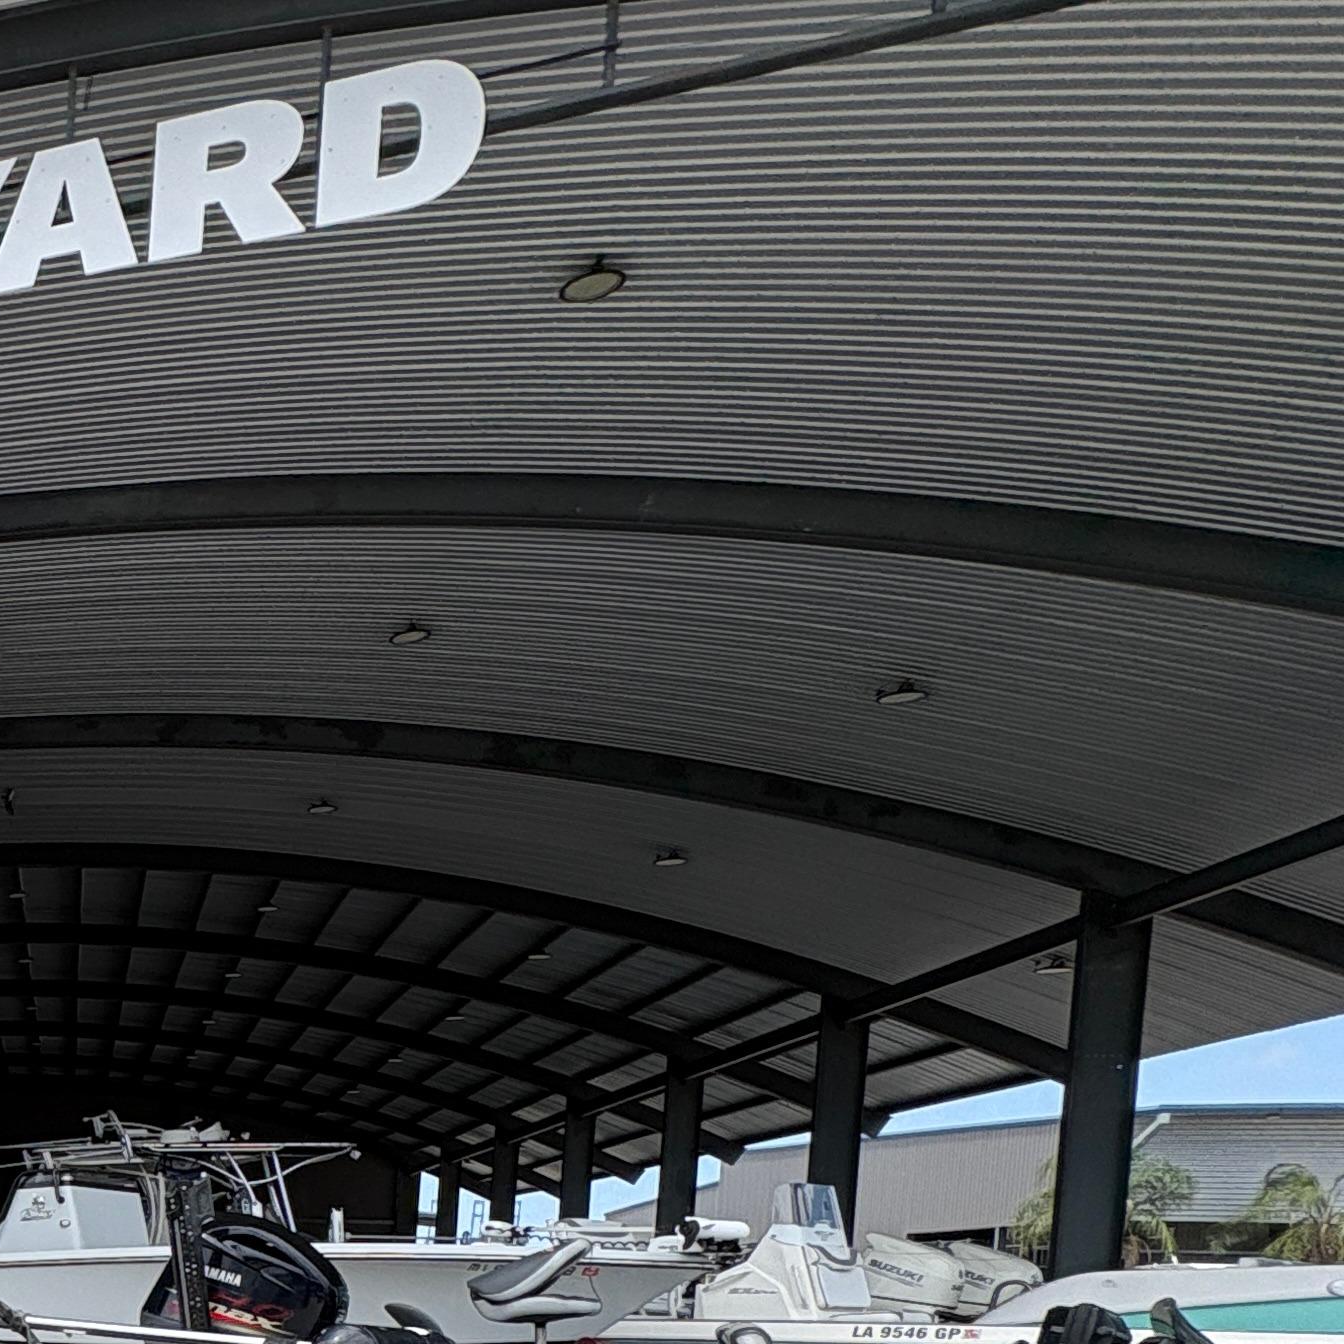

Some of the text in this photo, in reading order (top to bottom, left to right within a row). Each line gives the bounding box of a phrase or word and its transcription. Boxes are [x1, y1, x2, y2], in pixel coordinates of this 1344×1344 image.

[204, 1265, 242, 1287] AMAHA
[868, 1259, 924, 1282] SUZUKI
[851, 1326, 873, 1338] LA
[880, 1326, 928, 1339] 9546
[935, 1327, 961, 1340] GP
